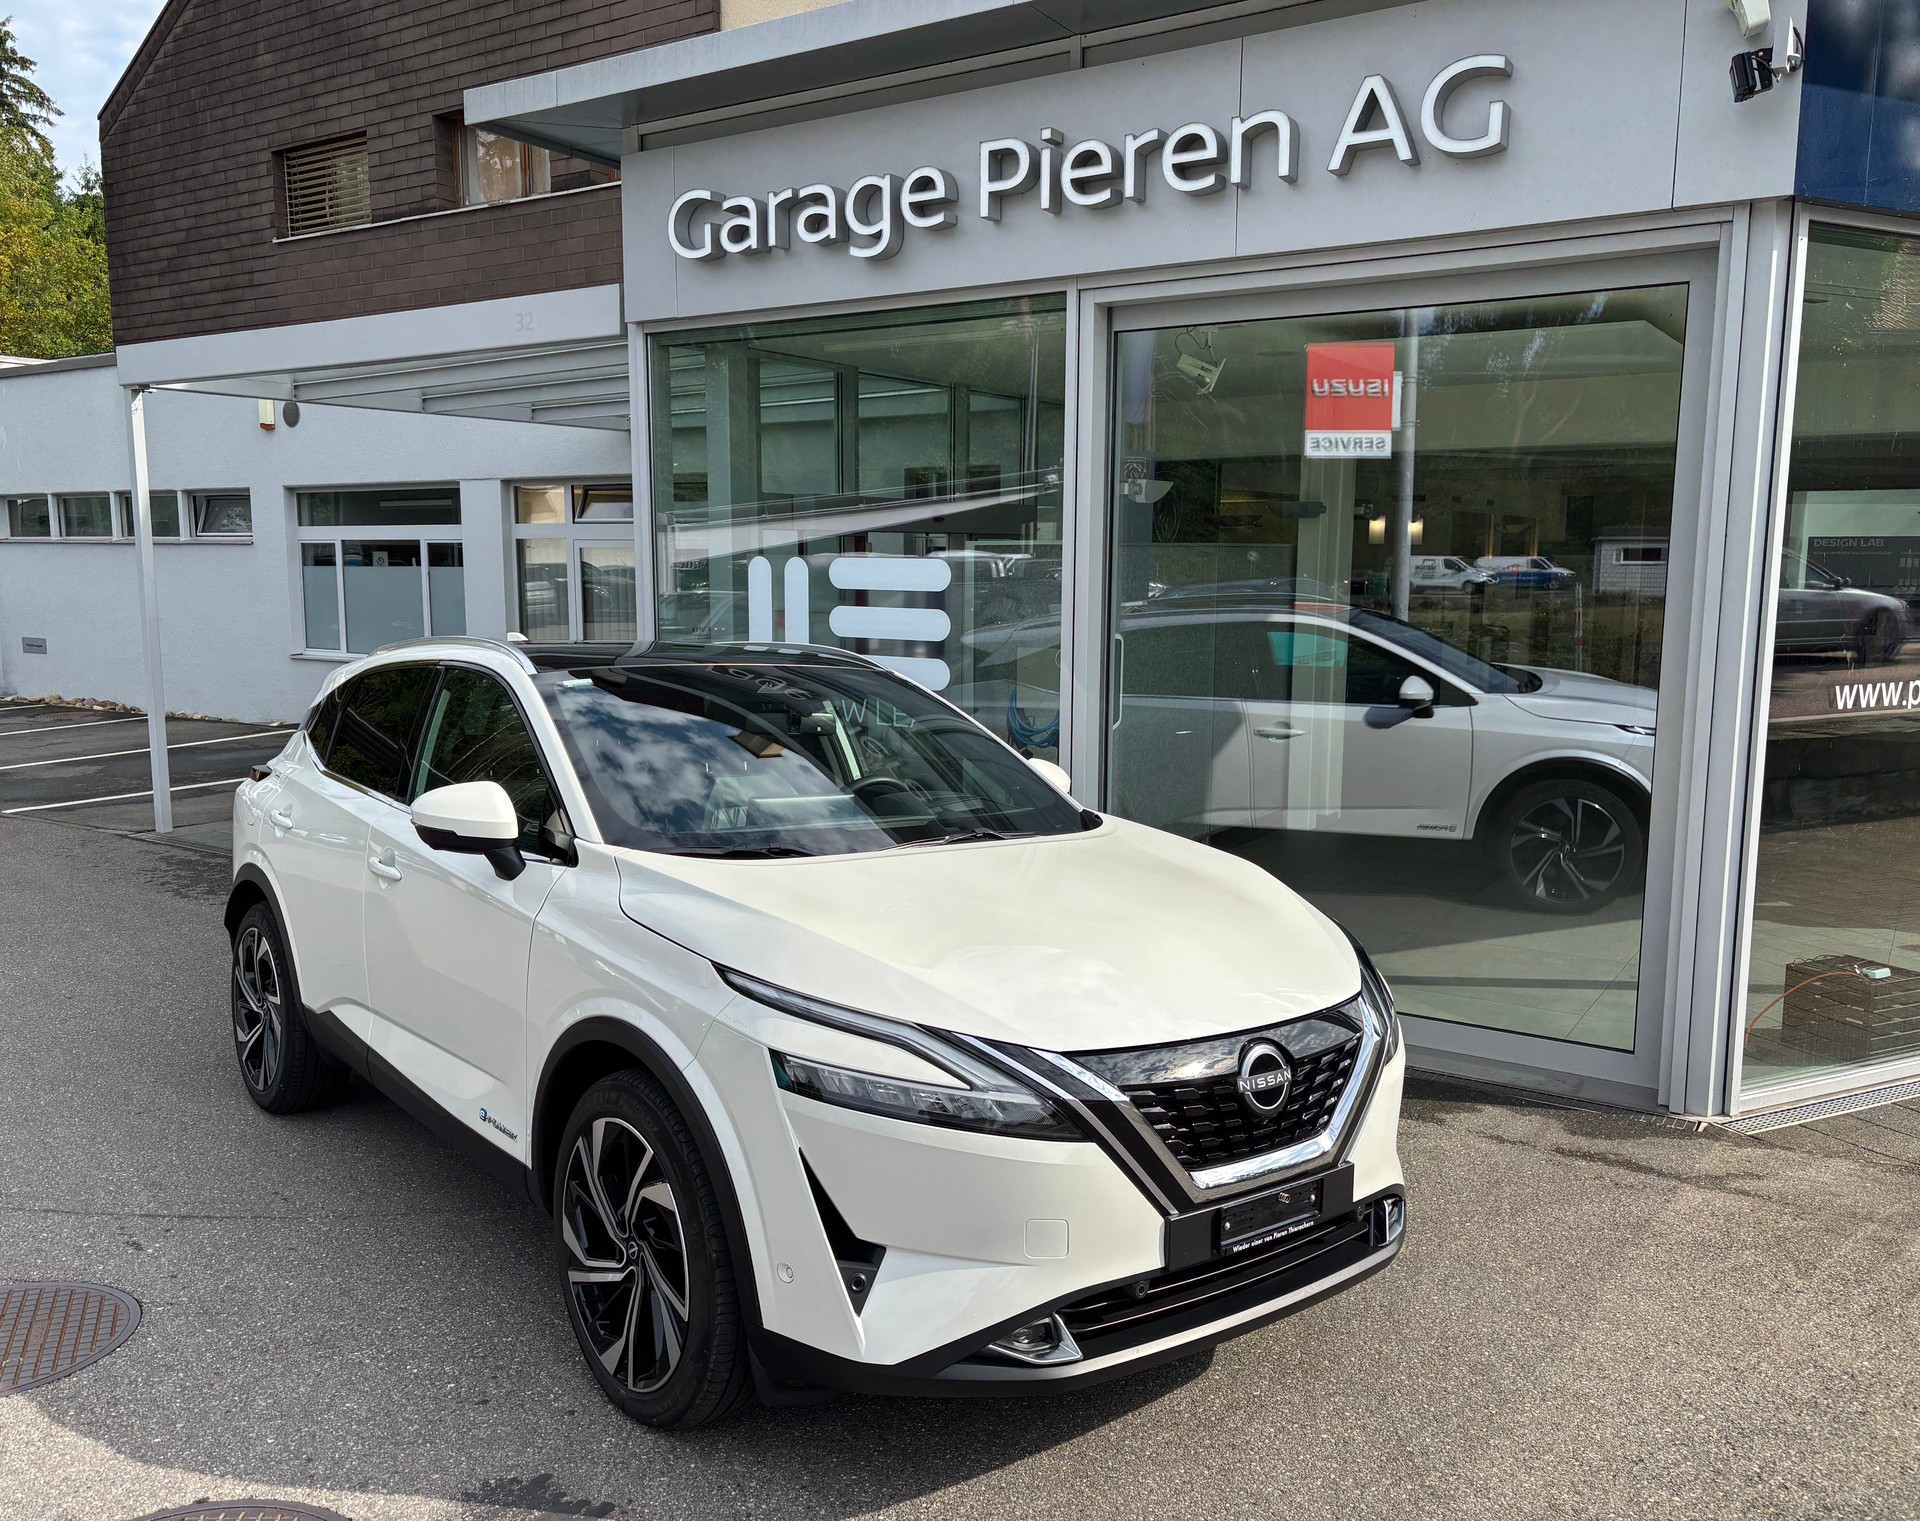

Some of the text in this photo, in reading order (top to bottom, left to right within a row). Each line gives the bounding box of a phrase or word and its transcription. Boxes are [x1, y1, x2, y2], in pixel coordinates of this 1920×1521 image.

[668, 54, 1513, 260] Garage Pieren AG
[515, 311, 534, 332] 32
[1813, 537, 1885, 547] DESIGN LAB
[1239, 1069, 1292, 1092] NISSAN
[1232, 1242, 1250, 1253] Wieder
[1251, 1237, 1263, 1247] einer
[1273, 1229, 1288, 1239] Pieren
